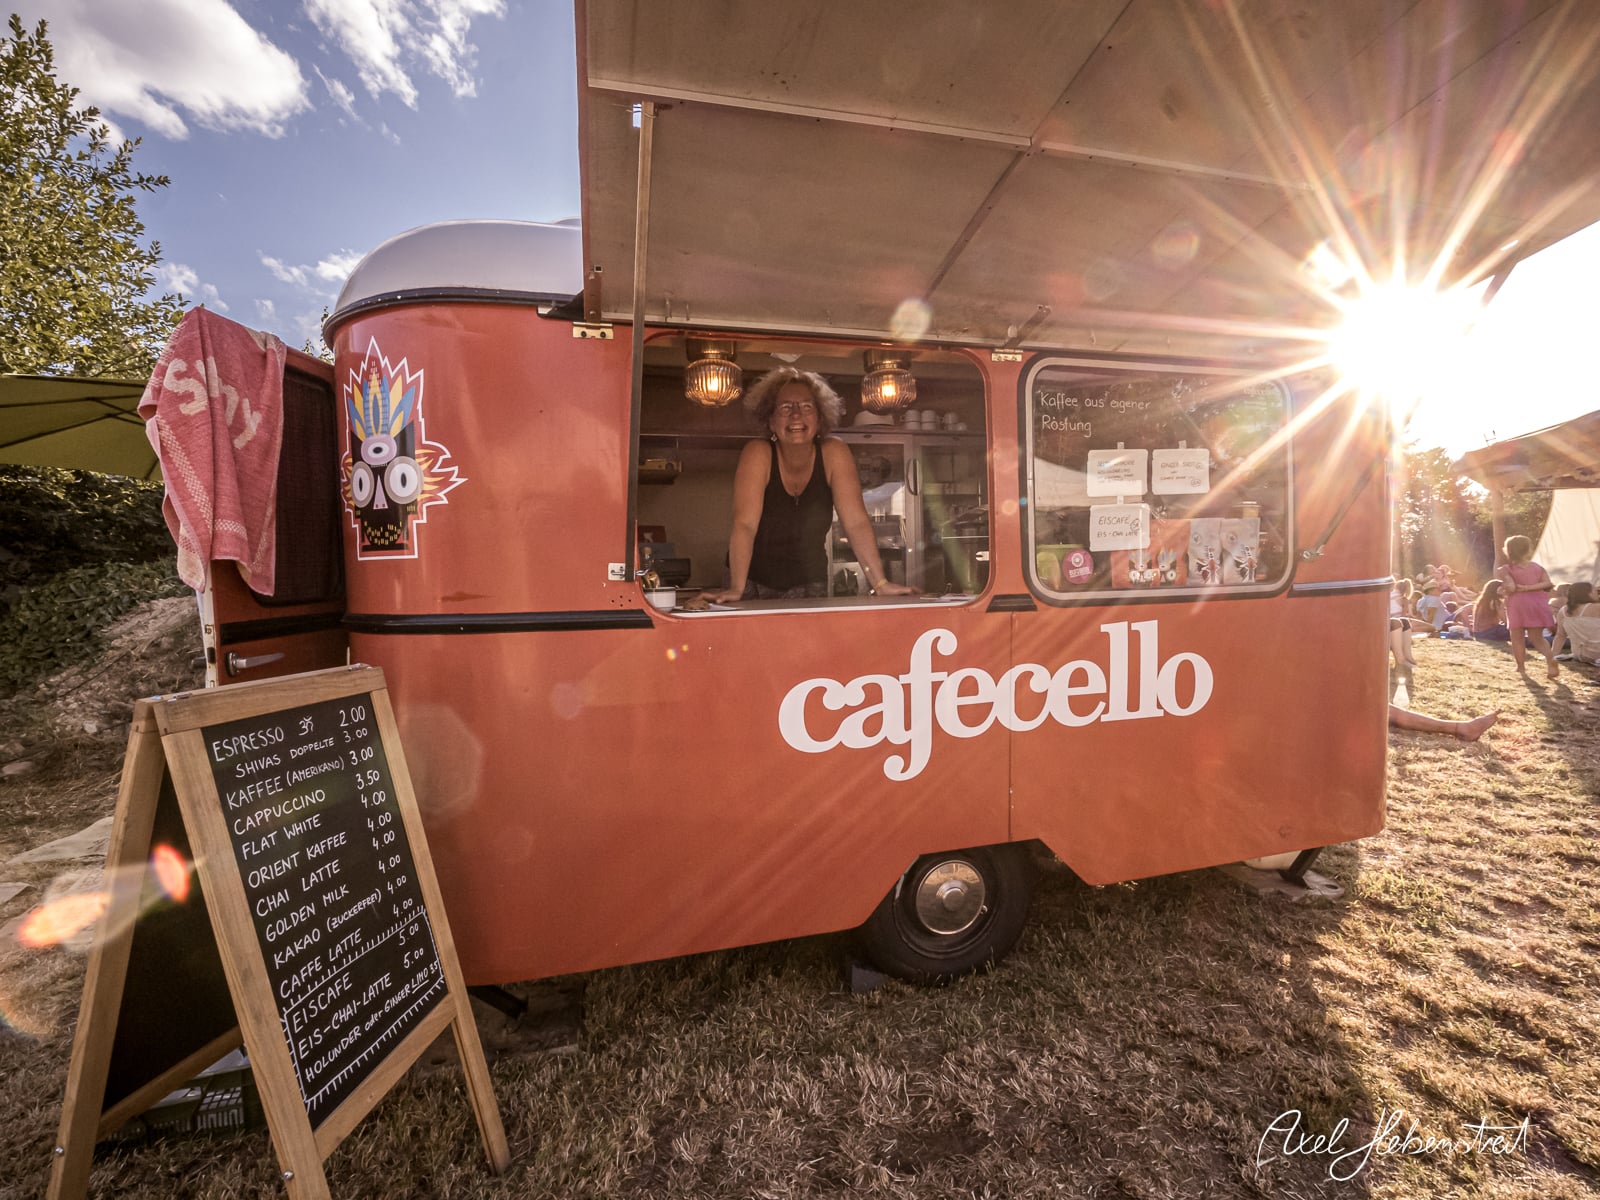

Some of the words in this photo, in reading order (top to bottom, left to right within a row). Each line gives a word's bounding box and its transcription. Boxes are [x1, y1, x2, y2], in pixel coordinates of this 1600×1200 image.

[1041, 392, 1078, 410] Kaffee
[1084, 398, 1105, 408] aus
[1110, 399, 1151, 414] eigener
[1042, 415, 1092, 438] Röstung
[212, 726, 285, 762] ESPRESSO
[339, 705, 366, 727] 2.00
[778, 619, 1214, 782] cafecello
[226, 776, 283, 811] KAFFEE
[286, 756, 345, 786] (AMERIKANO)
[350, 746, 374, 766] 3.00
[235, 754, 281, 778] SHIVAS
[290, 737, 335, 759] DOPPELTE
[343, 728, 368, 743] 3.00
[234, 789, 326, 835] CAPPUCCINO
[356, 770, 380, 790] 3.50
[241, 831, 279, 860] FLAT
[284, 813, 322, 840] WHITE
[361, 790, 386, 809] 4.00
[248, 852, 300, 889] ORIENT
[306, 831, 347, 861] KAFFEE
[367, 812, 392, 832] 4.00
[256, 889, 290, 917] CHAI
[301, 859, 341, 892] LATTE
[372, 830, 395, 851] 4.00
[266, 902, 316, 942] GOLDEN
[323, 884, 350, 908] MILK
[378, 854, 401, 874] 4.00
[273, 928, 321, 970] KAKAO
[326, 888, 382, 932] (ZUCKERFREI)
[387, 875, 407, 895] 4.00
[280, 956, 323, 999] CAFFE
[328, 927, 362, 962] LATTE
[393, 898, 413, 918] 4.00
[292, 972, 353, 1034] EISCAFE
[399, 922, 419, 946] 5.00
[298, 972, 393, 1060] EIS-CHAI-LATTE
[403, 948, 424, 969] 5.00
[305, 1025, 362, 1083] HOLUNDER
[364, 1010, 383, 1032] oder
[384, 984, 411, 1013] GINGER
[411, 967, 429, 989] LIMO
